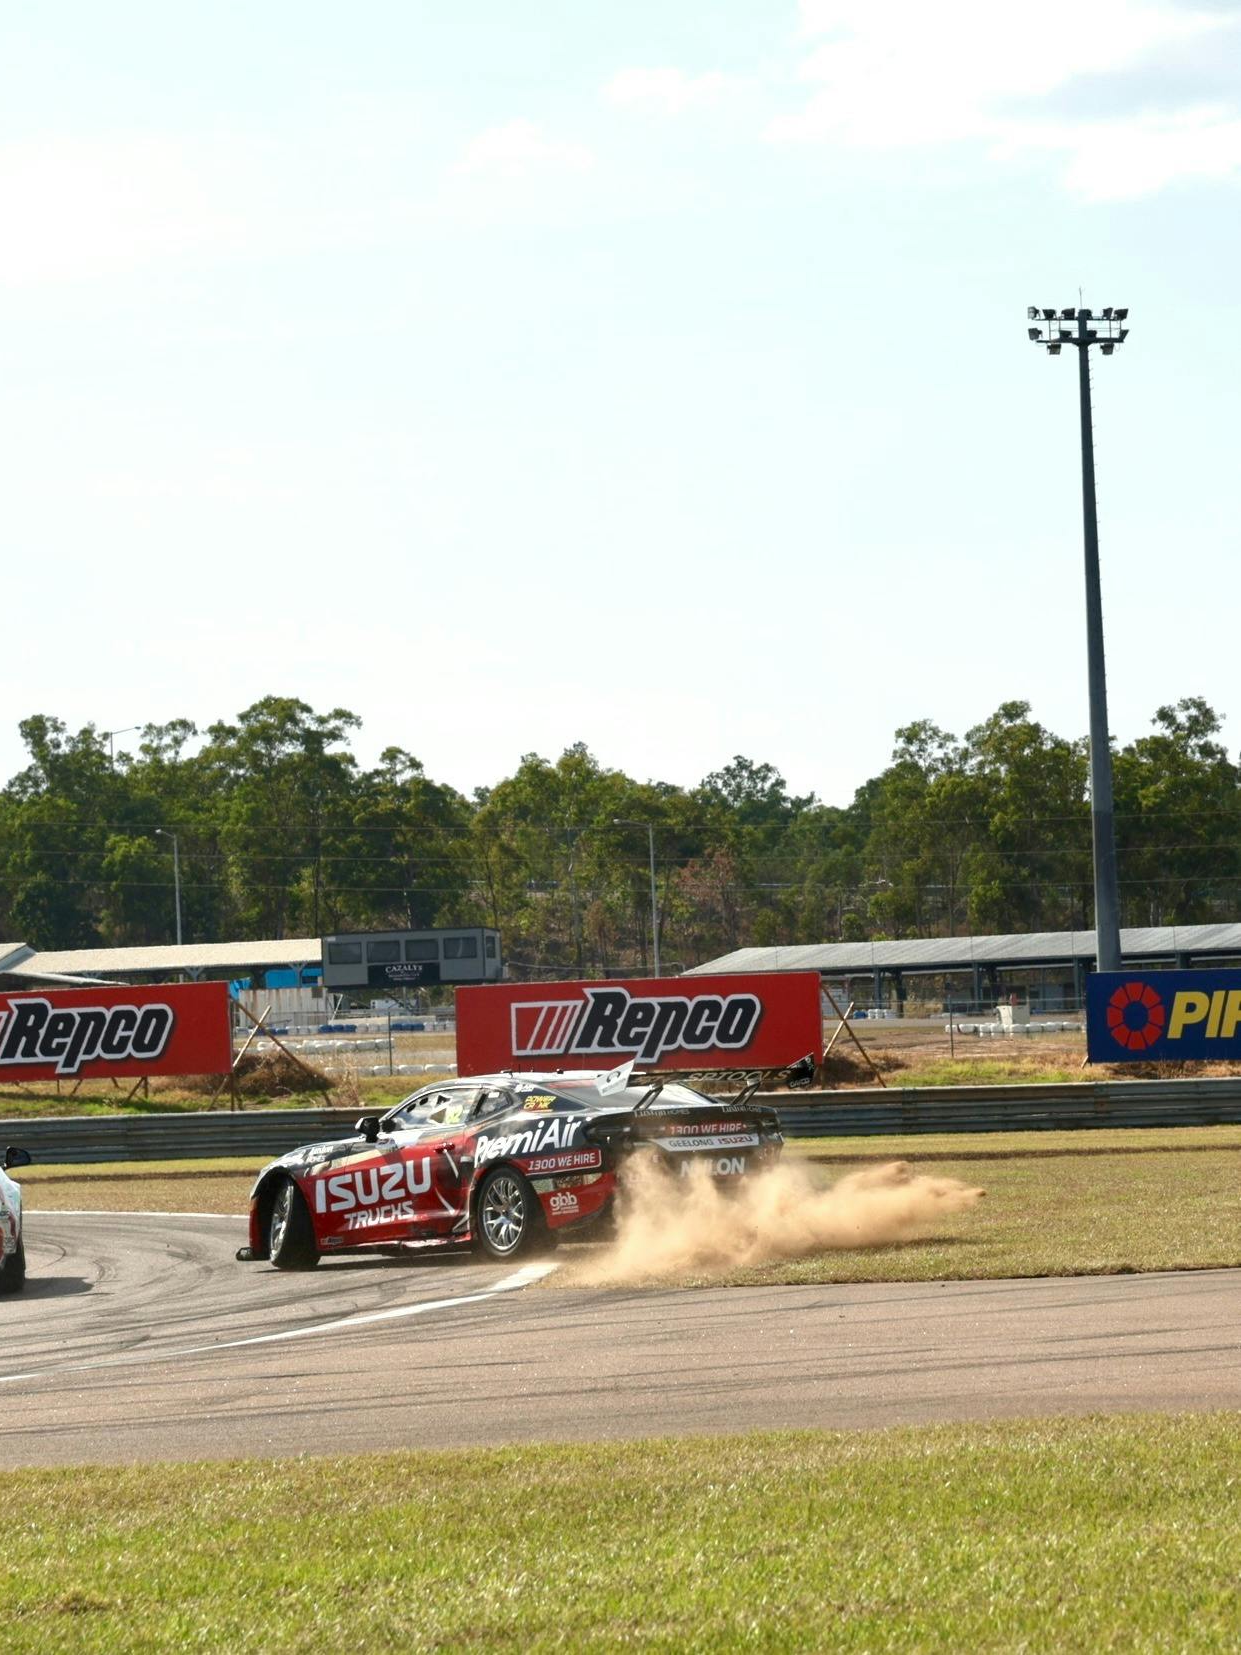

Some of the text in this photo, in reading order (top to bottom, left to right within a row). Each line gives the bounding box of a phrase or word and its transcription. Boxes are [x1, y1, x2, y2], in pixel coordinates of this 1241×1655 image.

[569, 987, 761, 1064] Repco
[474, 1115, 582, 1168] PremiAir
[669, 1135, 753, 1148] GEELONG ISUZU
[528, 1153, 596, 1171] 1300 WE HIRE
[315, 1157, 431, 1213] ISUZU
[344, 1201, 414, 1230] TRUCKS
[550, 1191, 577, 1211] gbb
